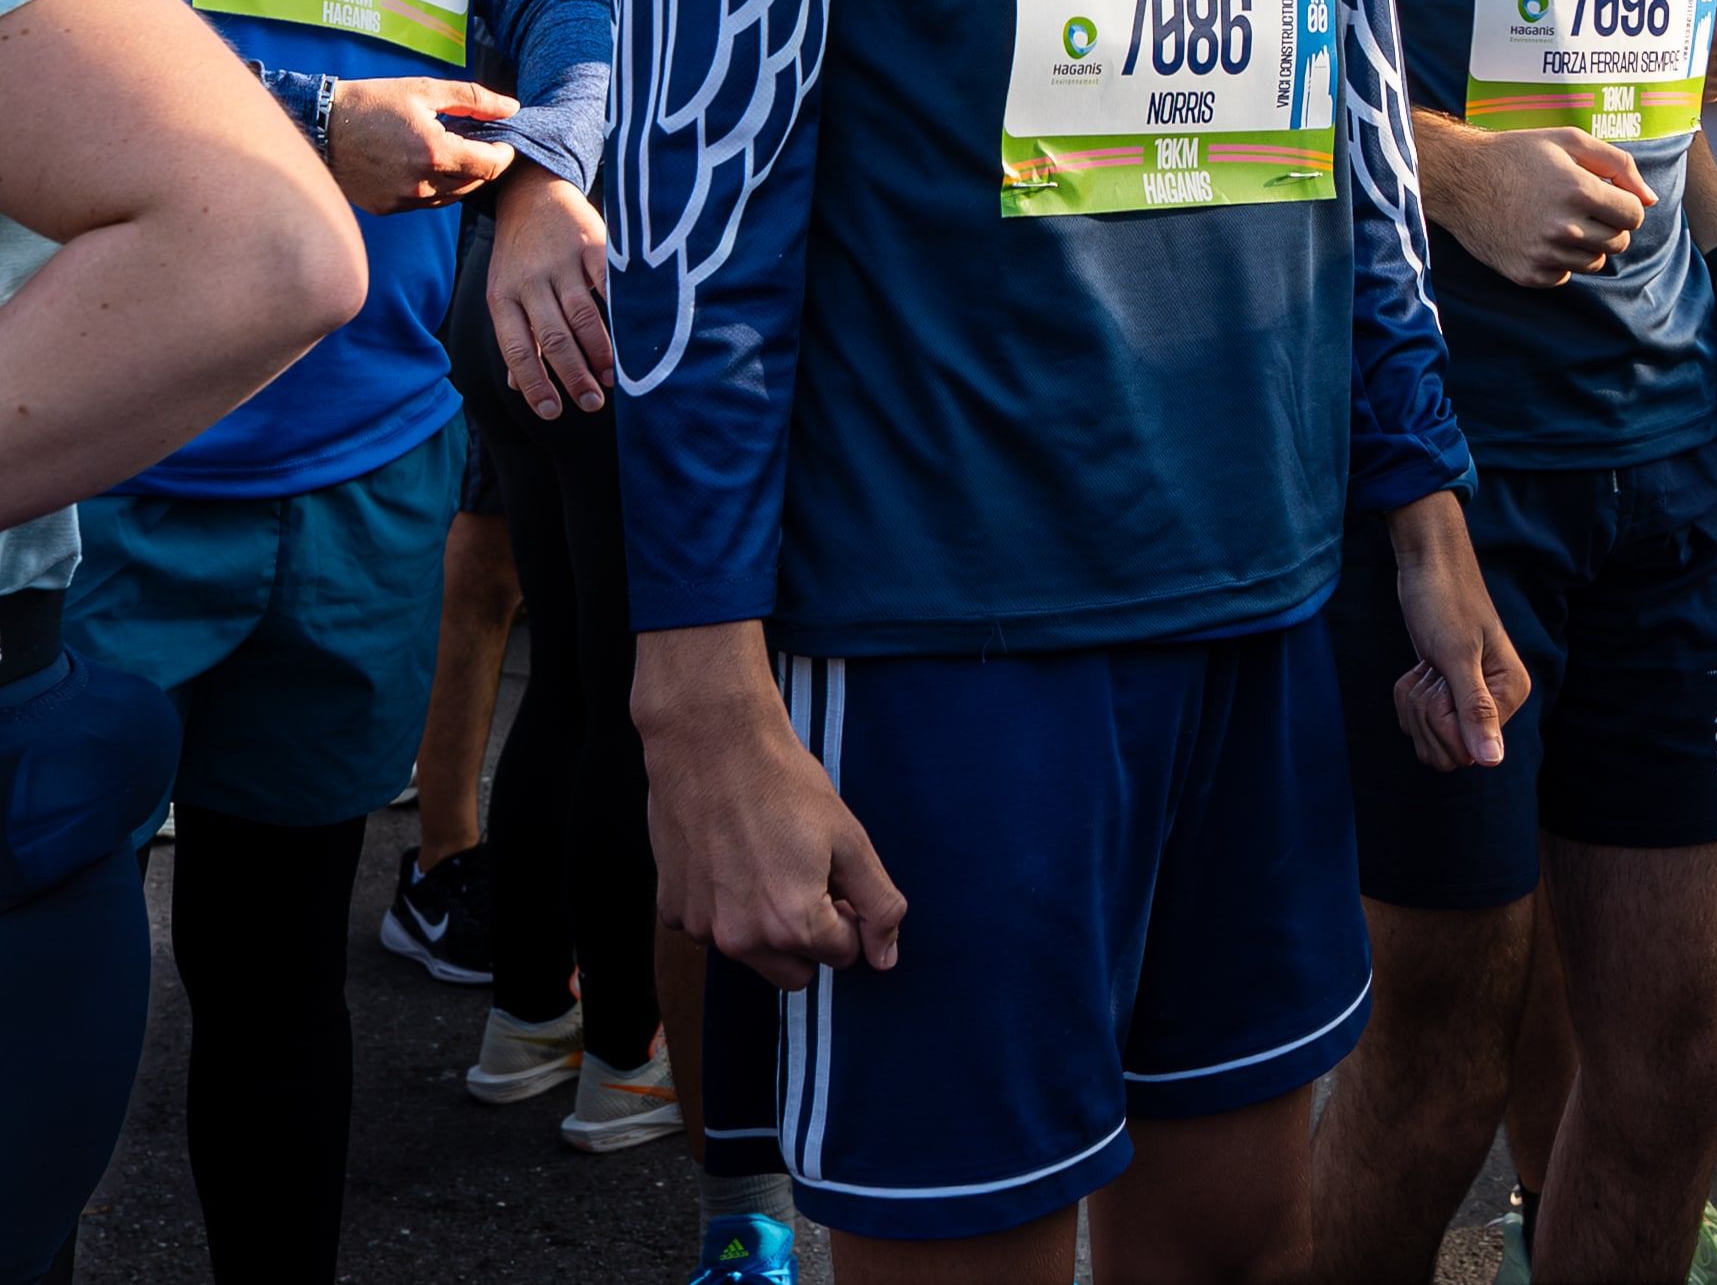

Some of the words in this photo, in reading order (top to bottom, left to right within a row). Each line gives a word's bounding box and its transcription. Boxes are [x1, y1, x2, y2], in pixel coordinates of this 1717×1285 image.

[322, 0, 381, 33] HAGANIS
[1543, 51, 1587, 74] FORZA
[1590, 51, 1640, 74] FERRARI
[1146, 90, 1216, 125] NORRIS
[1276, 80, 1291, 108] VINCI
[1602, 85, 1635, 112] 10KM
[1592, 112, 1641, 139] HAGANIS
[1155, 137, 1199, 170] 10KM
[1143, 170, 1213, 204] HAGANIS
